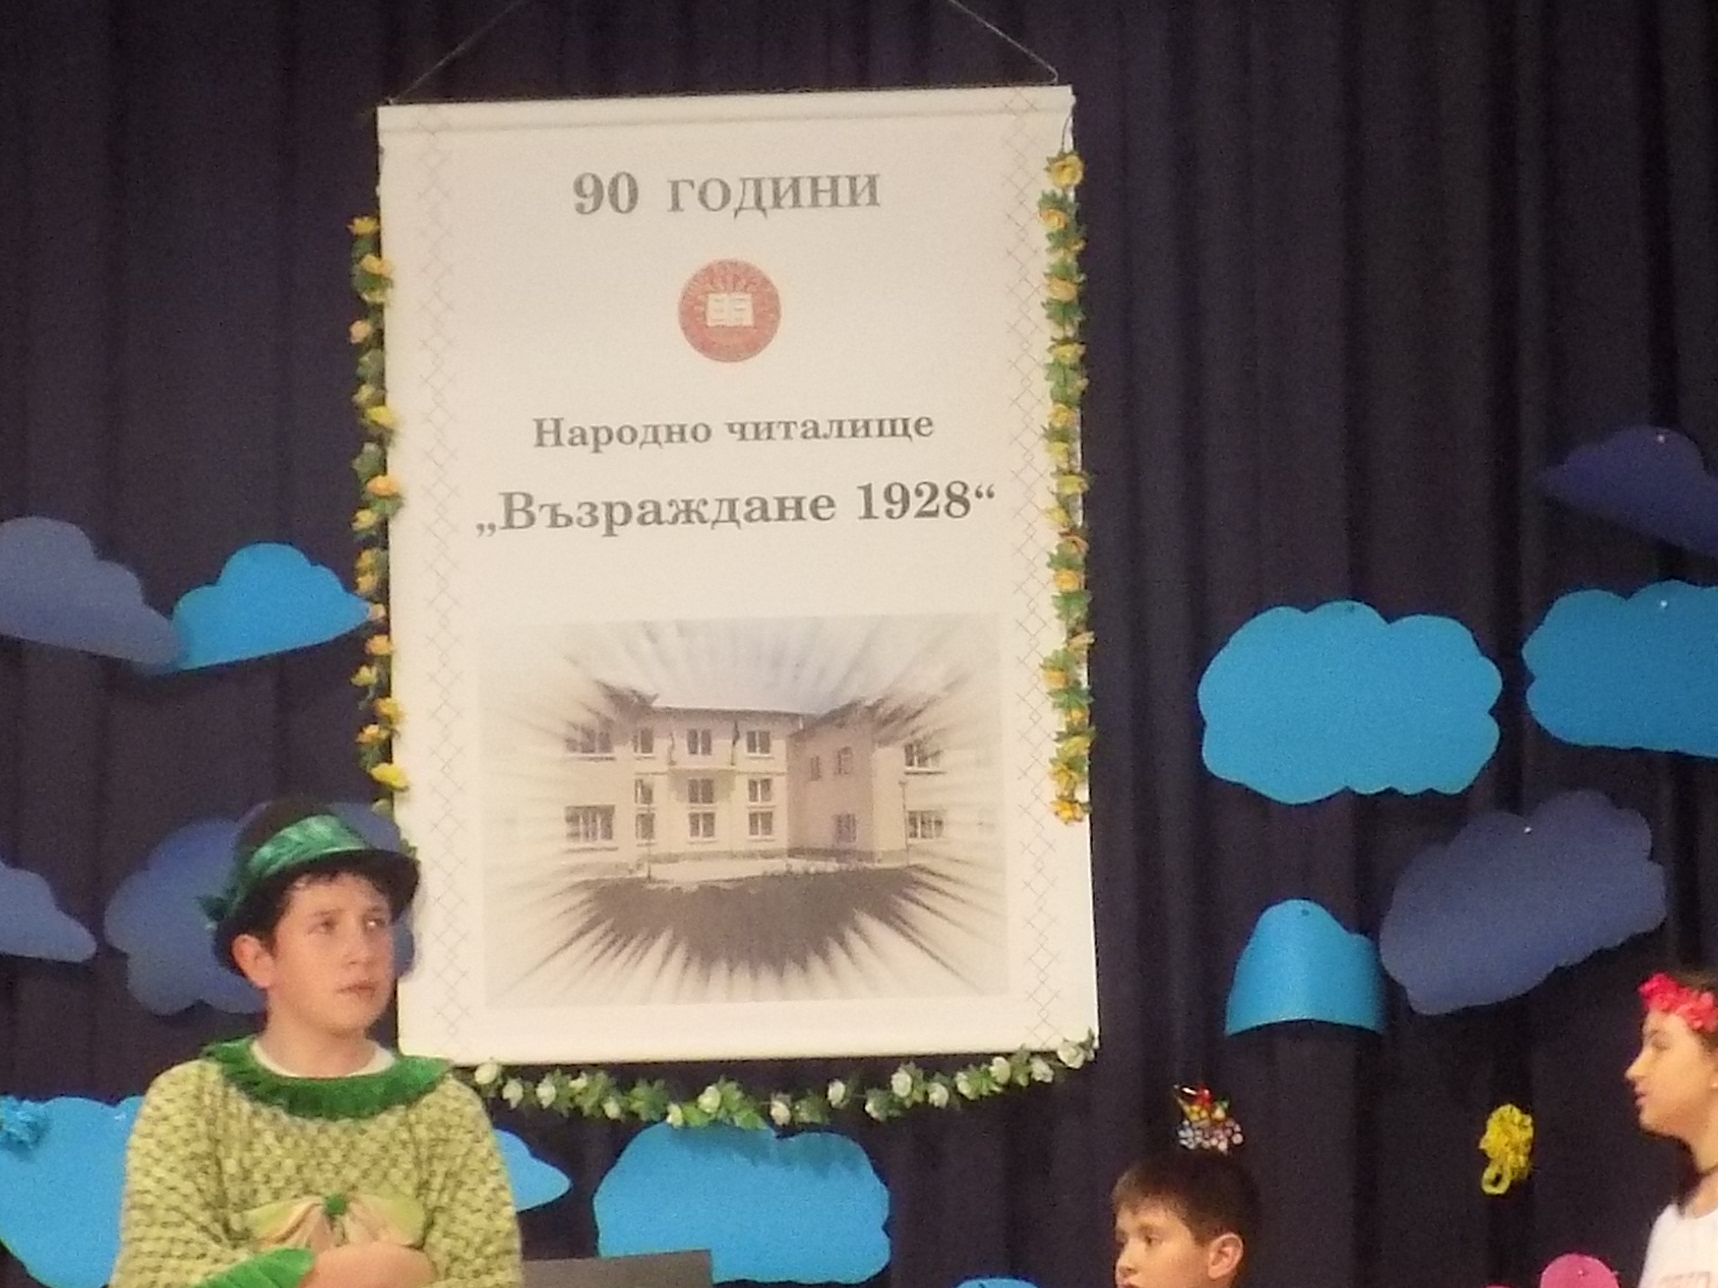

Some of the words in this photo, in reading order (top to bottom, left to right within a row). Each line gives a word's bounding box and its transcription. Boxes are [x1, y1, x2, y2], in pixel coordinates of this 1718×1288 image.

[572, 170, 640, 216] 90
[666, 172, 881, 220] години
[532, 416, 713, 454] Народно
[724, 415, 935, 444] читалище
[474, 491, 837, 538] „Възраждане
[856, 479, 996, 521] 1928“
